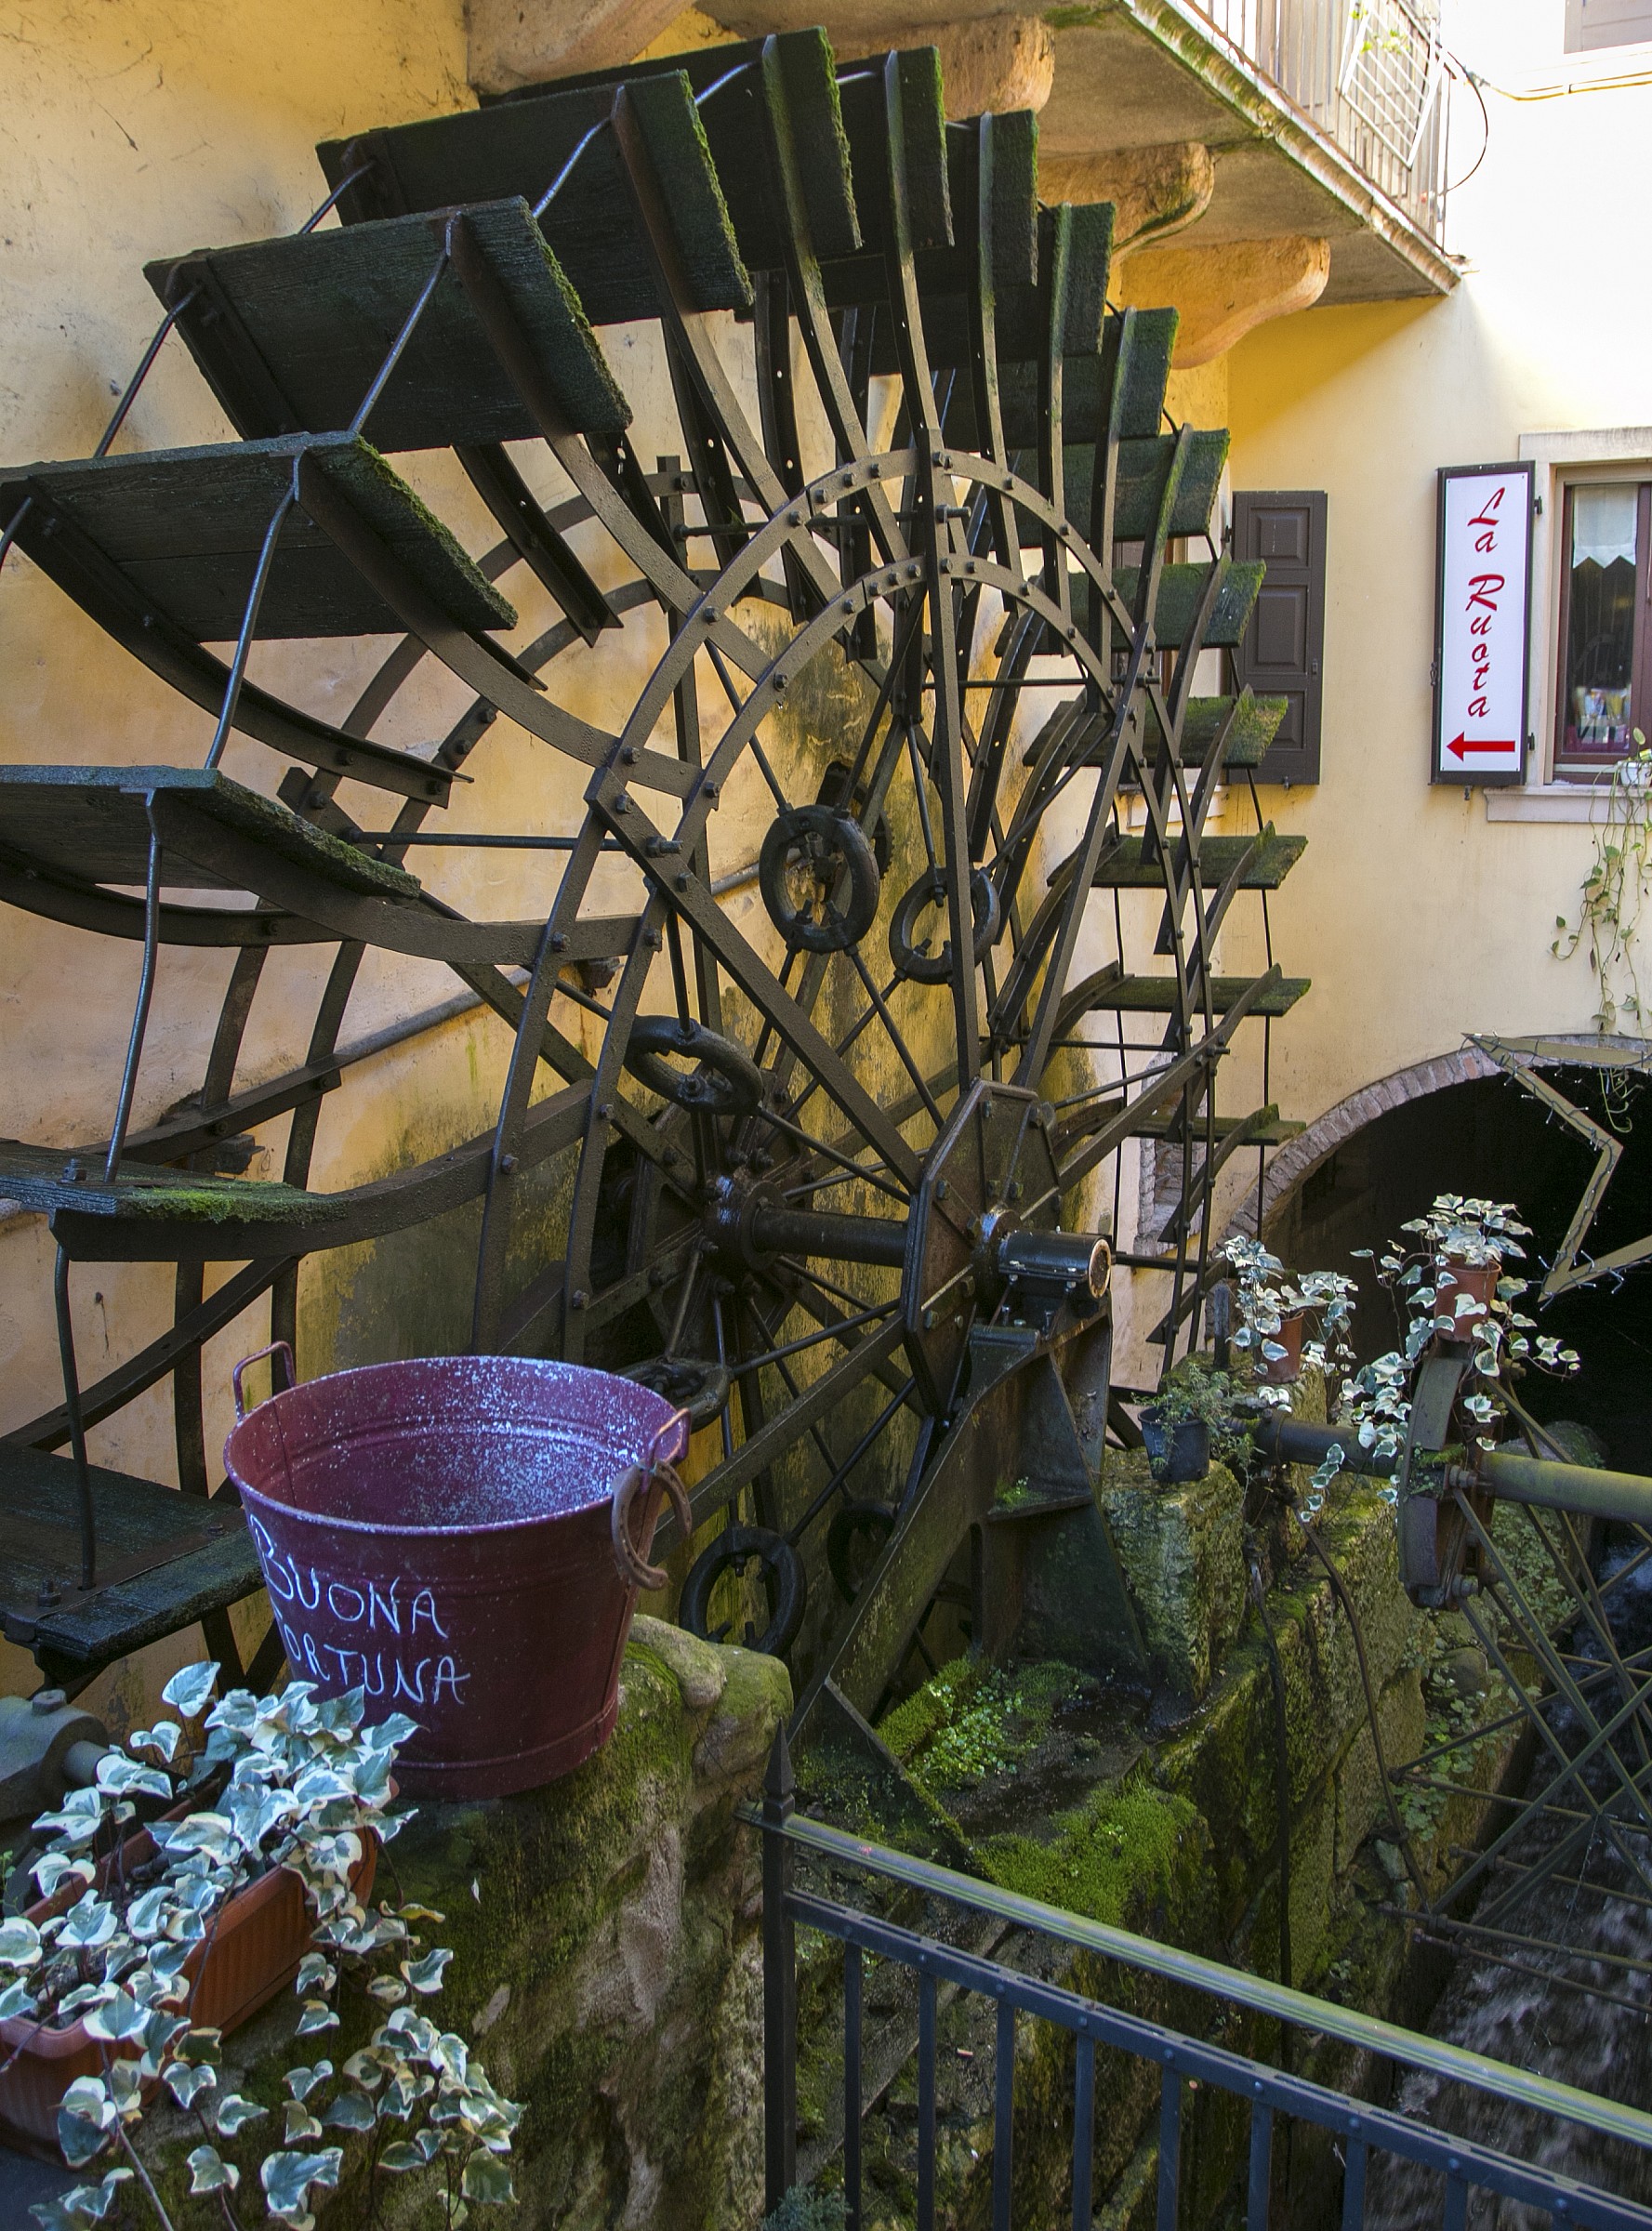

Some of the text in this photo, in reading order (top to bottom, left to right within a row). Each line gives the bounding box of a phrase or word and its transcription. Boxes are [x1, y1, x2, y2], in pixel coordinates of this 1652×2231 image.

[1464, 486, 1506, 718] La Ruota
[249, 1513, 448, 1639] BUONA
